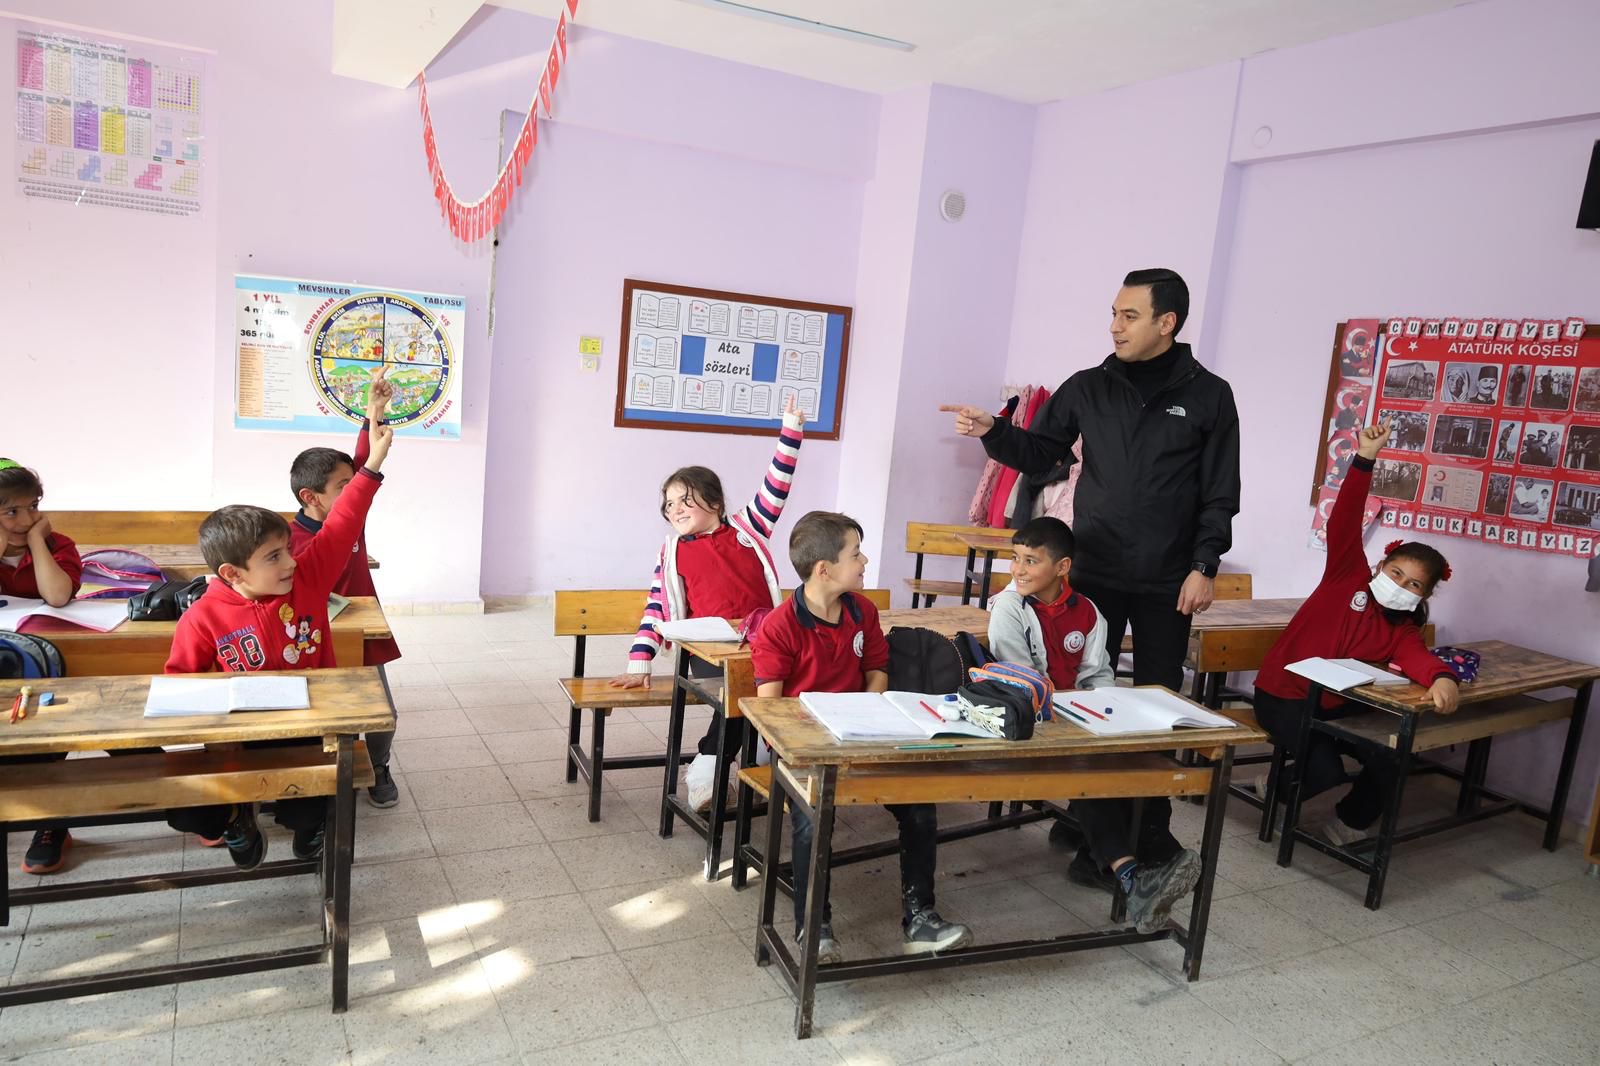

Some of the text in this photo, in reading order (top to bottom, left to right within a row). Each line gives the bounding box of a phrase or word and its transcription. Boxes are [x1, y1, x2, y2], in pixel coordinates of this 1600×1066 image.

[253, 293, 258, 301] 1
[240, 329, 257, 337] 365
[1392, 323, 1581, 337] CUMHURİYET
[718, 342, 741, 354] Ata
[1447, 341, 1579, 359] ATATÜRK KÖŞESİ
[705, 360, 751, 376] sözleri
[316, 401, 330, 416] YAZ
[1386, 511, 1590, 552] ÇOCUKLARIYIZ
[218, 633, 266, 672] 28
